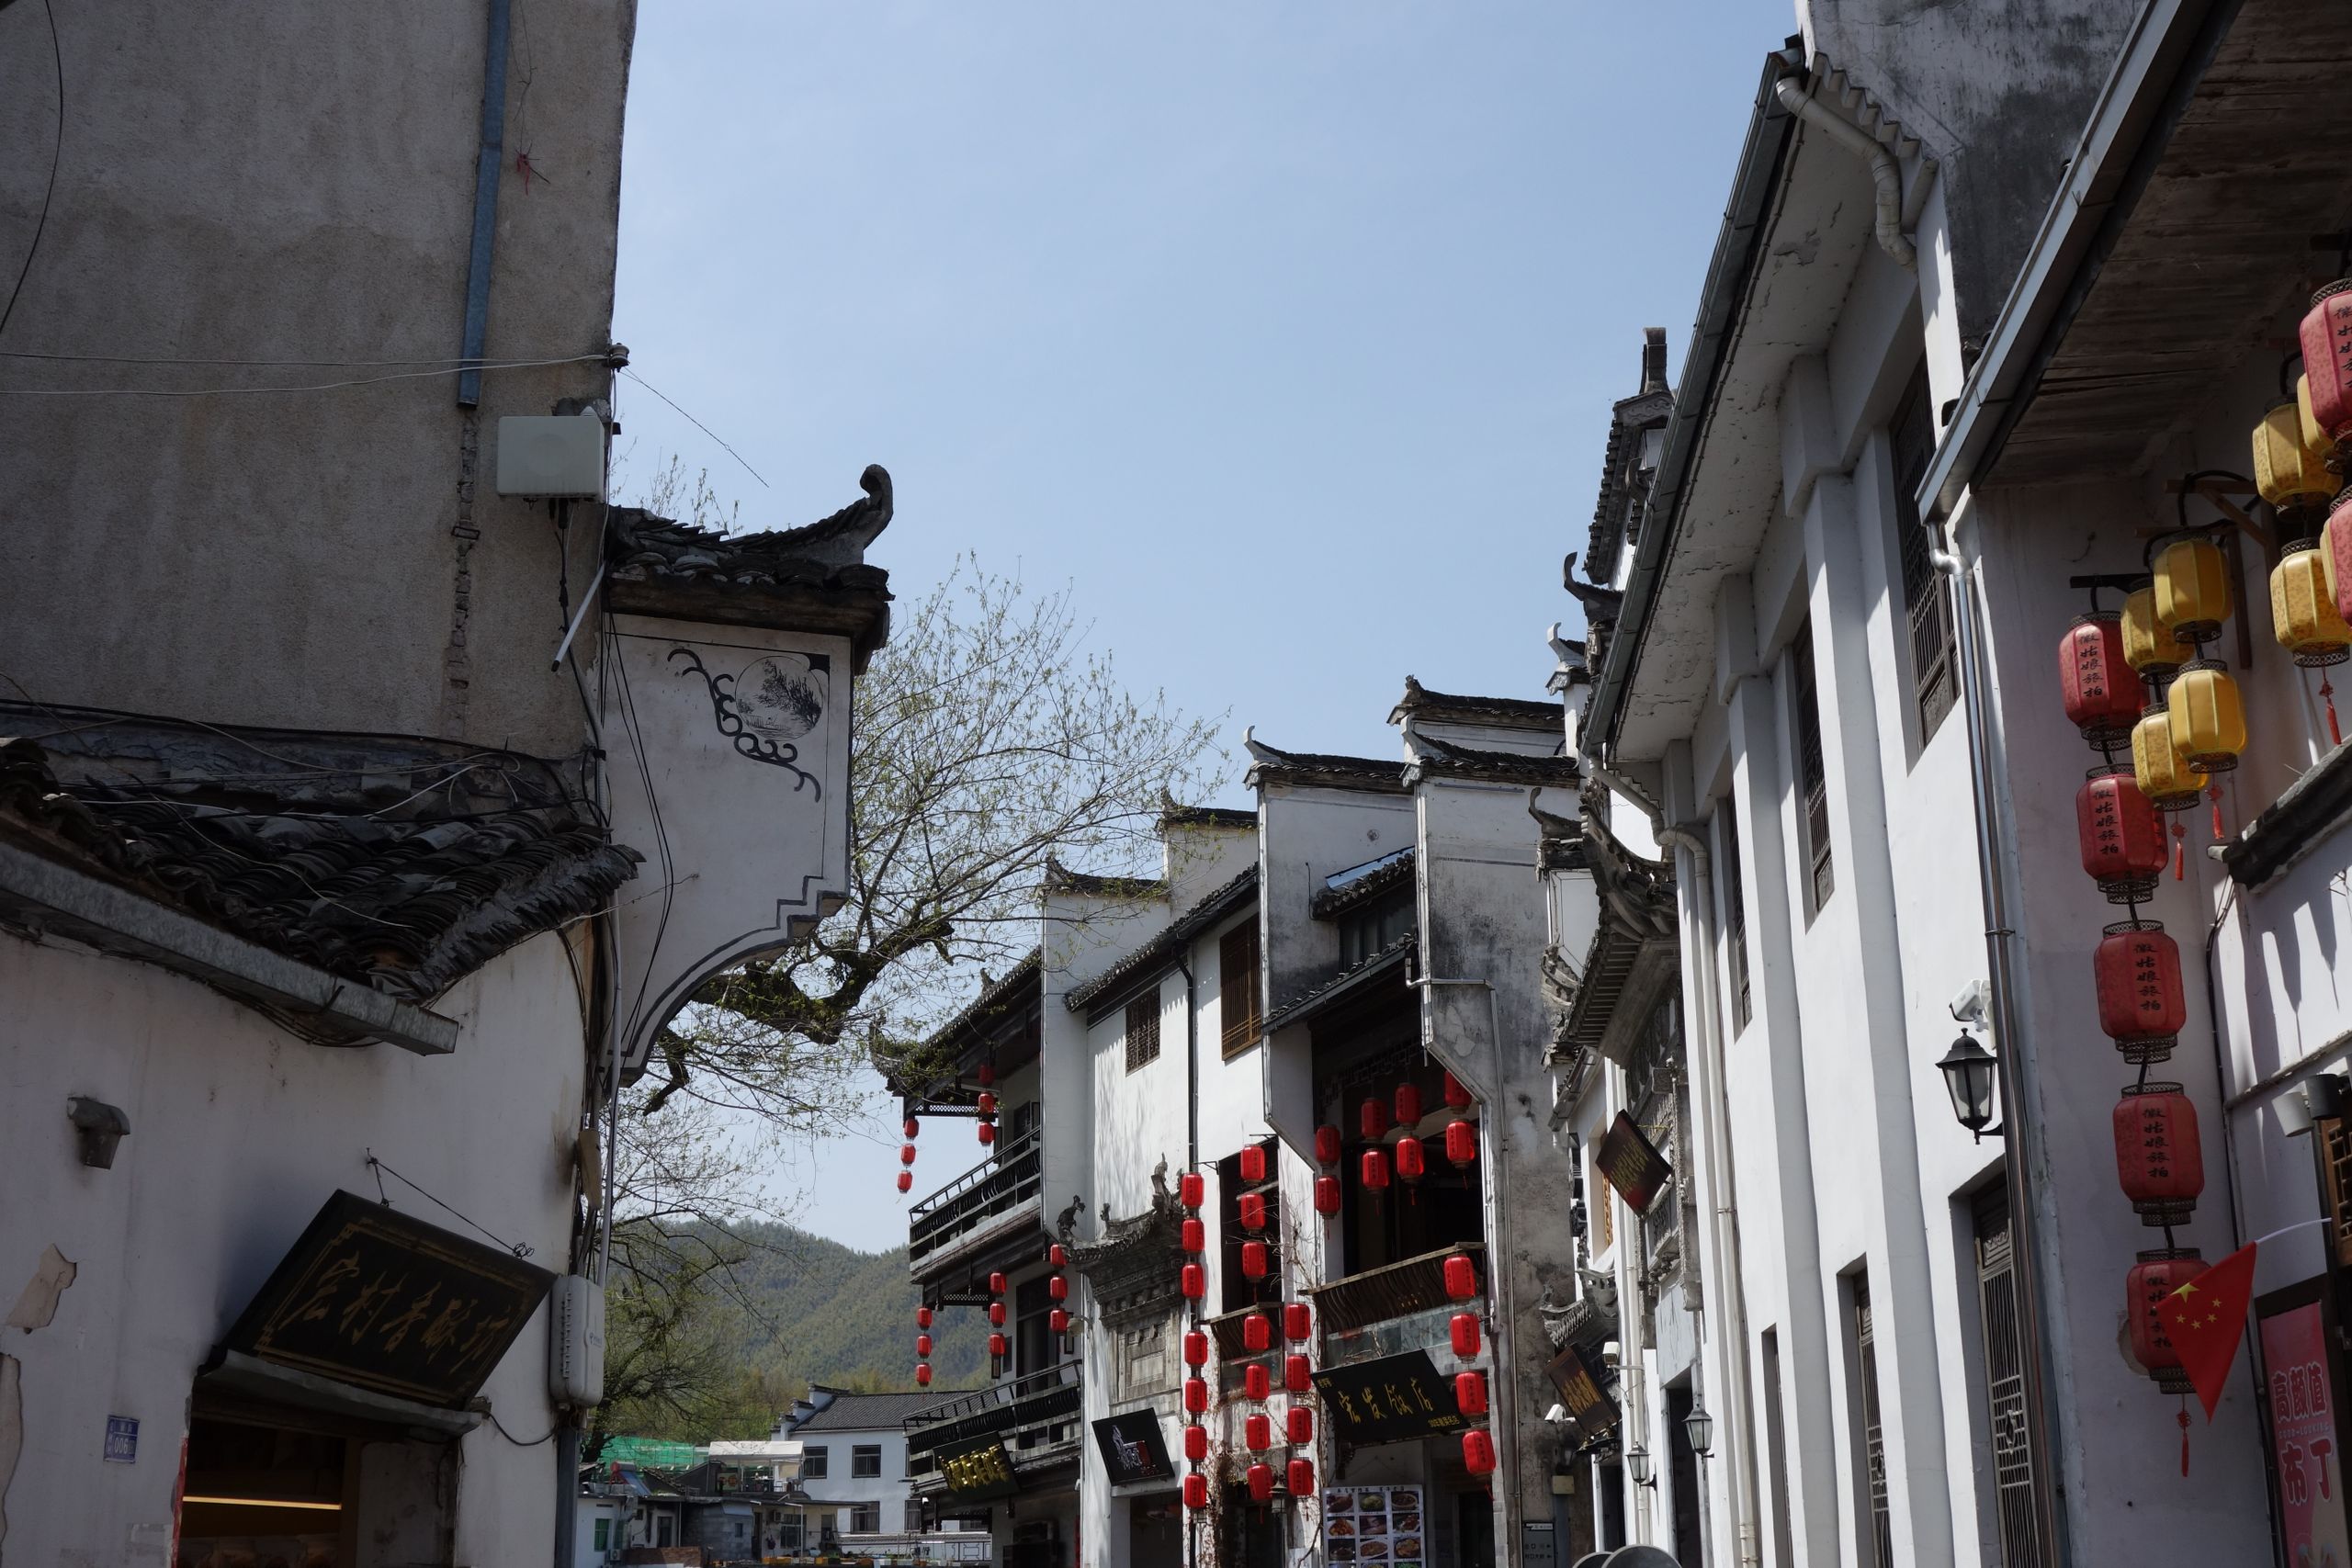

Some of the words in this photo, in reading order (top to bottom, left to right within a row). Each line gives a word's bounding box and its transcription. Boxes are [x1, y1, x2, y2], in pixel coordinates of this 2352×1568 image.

[2078, 634, 2103, 697] 徽姑娘旅拍
[2093, 789, 2120, 854] 徽姑娘旅拍
[2133, 943, 2161, 1010] 徽姑娘旅拍
[2143, 1108, 2170, 1178] 徽姑娘旅拍
[2272, 1361, 2326, 1423] 高颜值
[2280, 1438, 2332, 1506] 布丁
